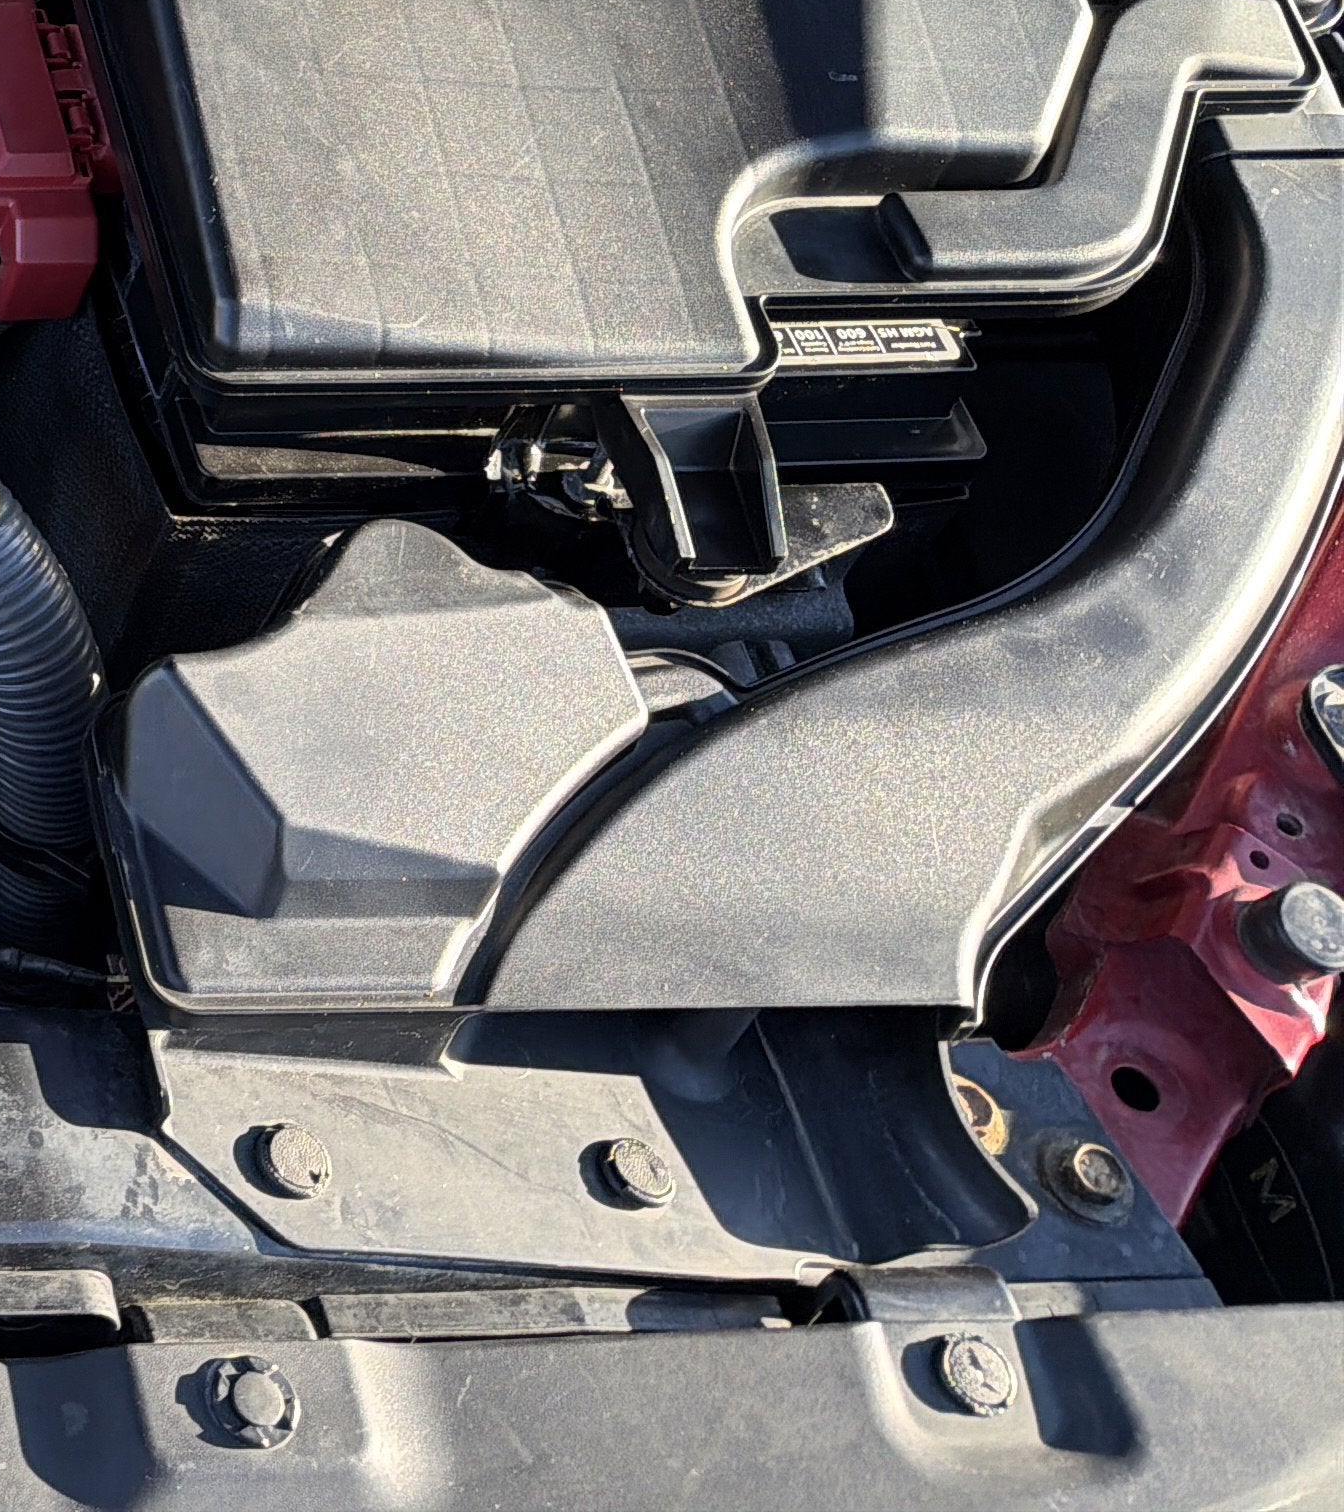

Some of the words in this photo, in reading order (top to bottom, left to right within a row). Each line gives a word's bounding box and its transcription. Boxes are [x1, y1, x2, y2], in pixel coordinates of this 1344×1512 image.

[794, 329, 824, 341] 100
[836, 327, 867, 340] 600
[900, 326, 934, 338] AGM
